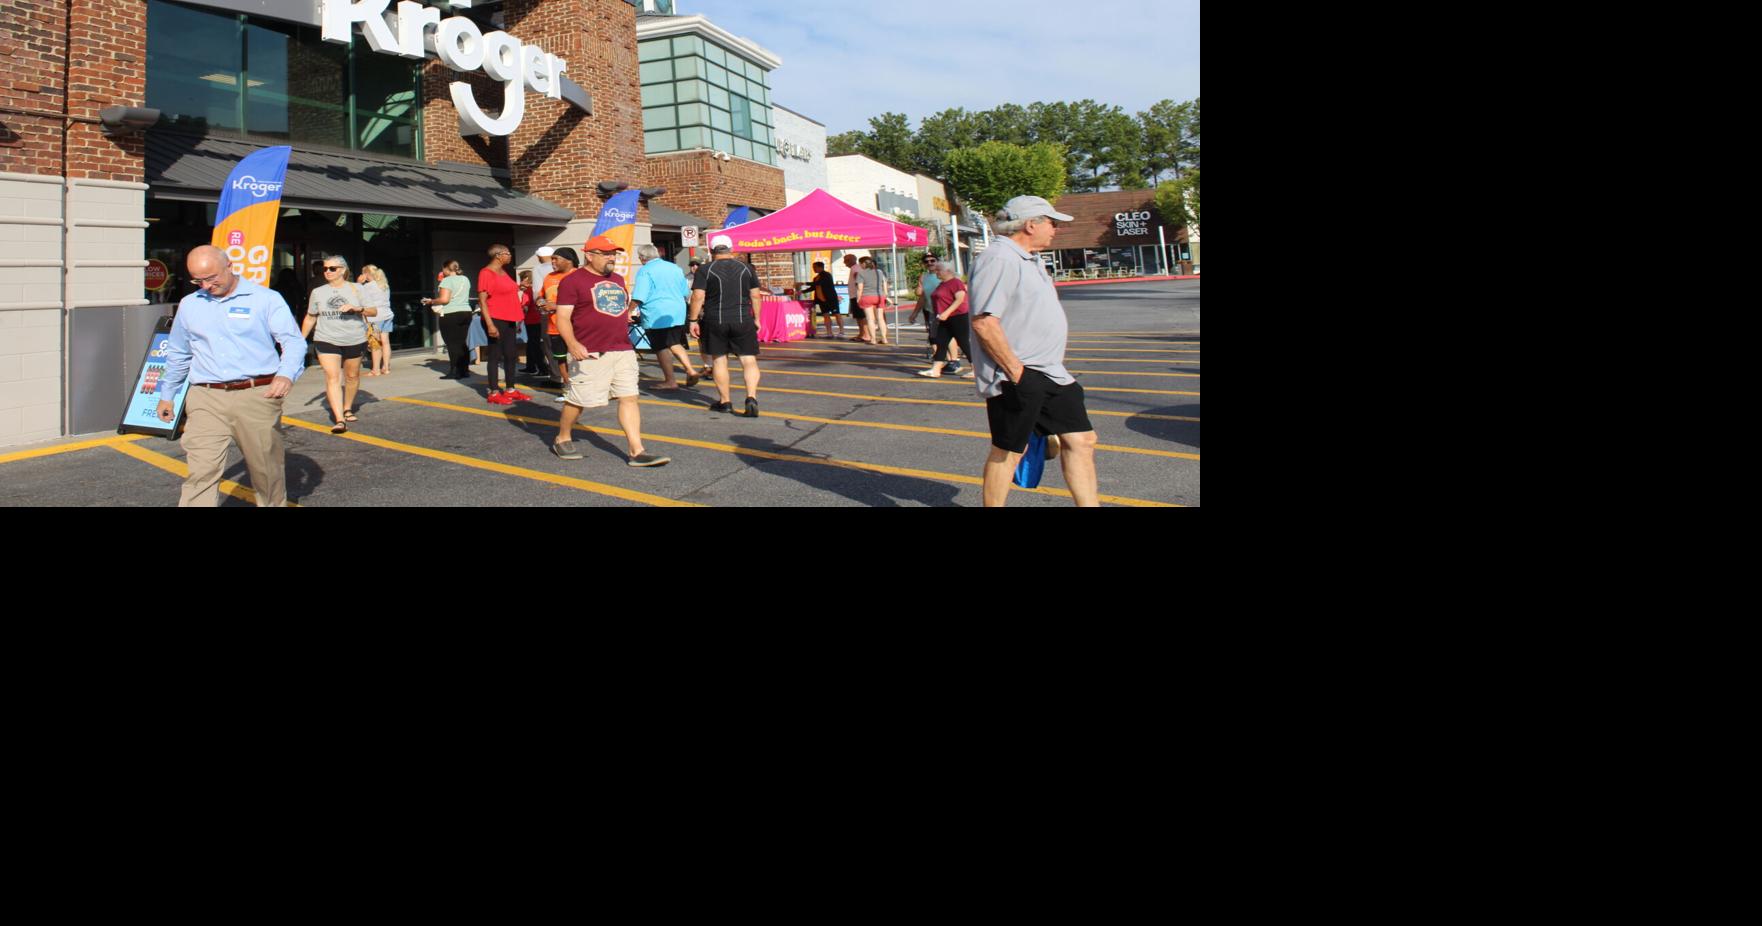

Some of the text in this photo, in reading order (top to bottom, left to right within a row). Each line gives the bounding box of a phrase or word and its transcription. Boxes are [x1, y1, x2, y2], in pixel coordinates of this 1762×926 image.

[321, 0, 567, 136] Kroger
[232, 175, 282, 198] Kroger
[604, 207, 635, 222] Kroger
[1115, 211, 1151, 221] CLEO
[1116, 221, 1139, 229] SKIN
[1117, 227, 1149, 236] LASER
[738, 230, 861, 248] soda's back, but better
